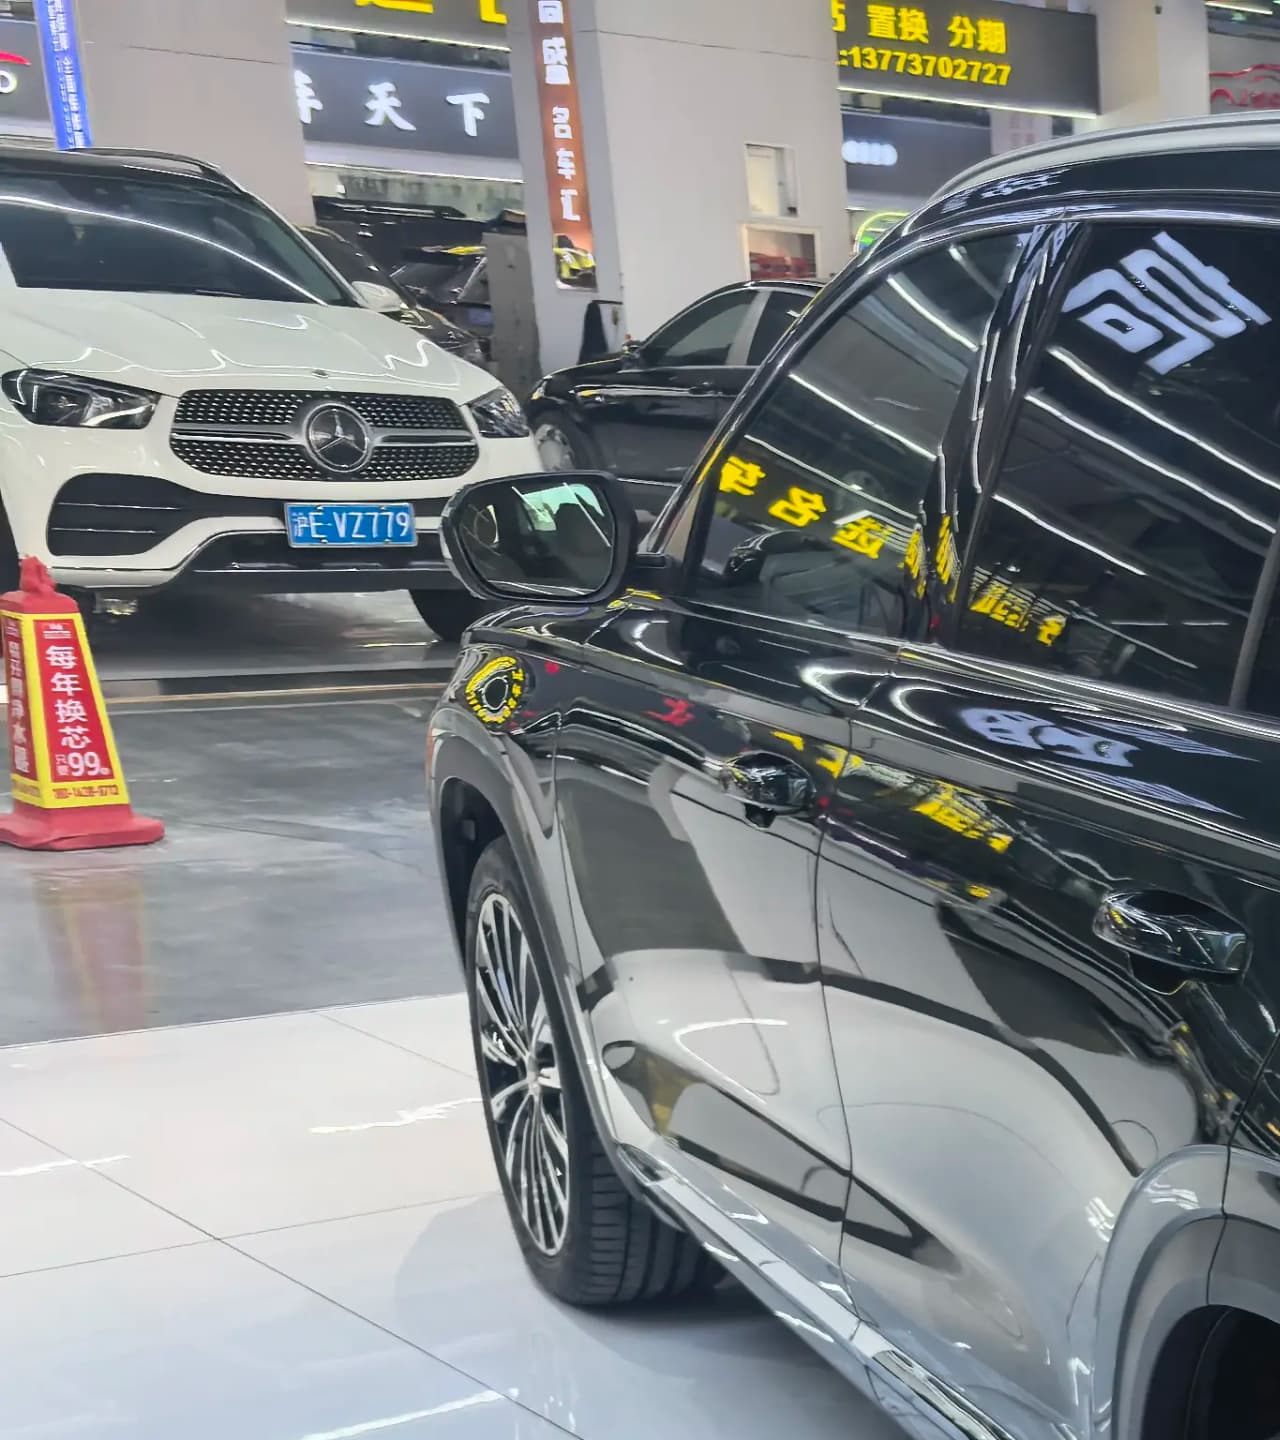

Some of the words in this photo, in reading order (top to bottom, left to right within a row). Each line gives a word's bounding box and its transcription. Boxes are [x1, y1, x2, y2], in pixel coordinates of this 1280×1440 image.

[867, 4, 930, 44] 置换
[947, 15, 1007, 55] 分期
[834, 46, 1012, 86] :13773702727
